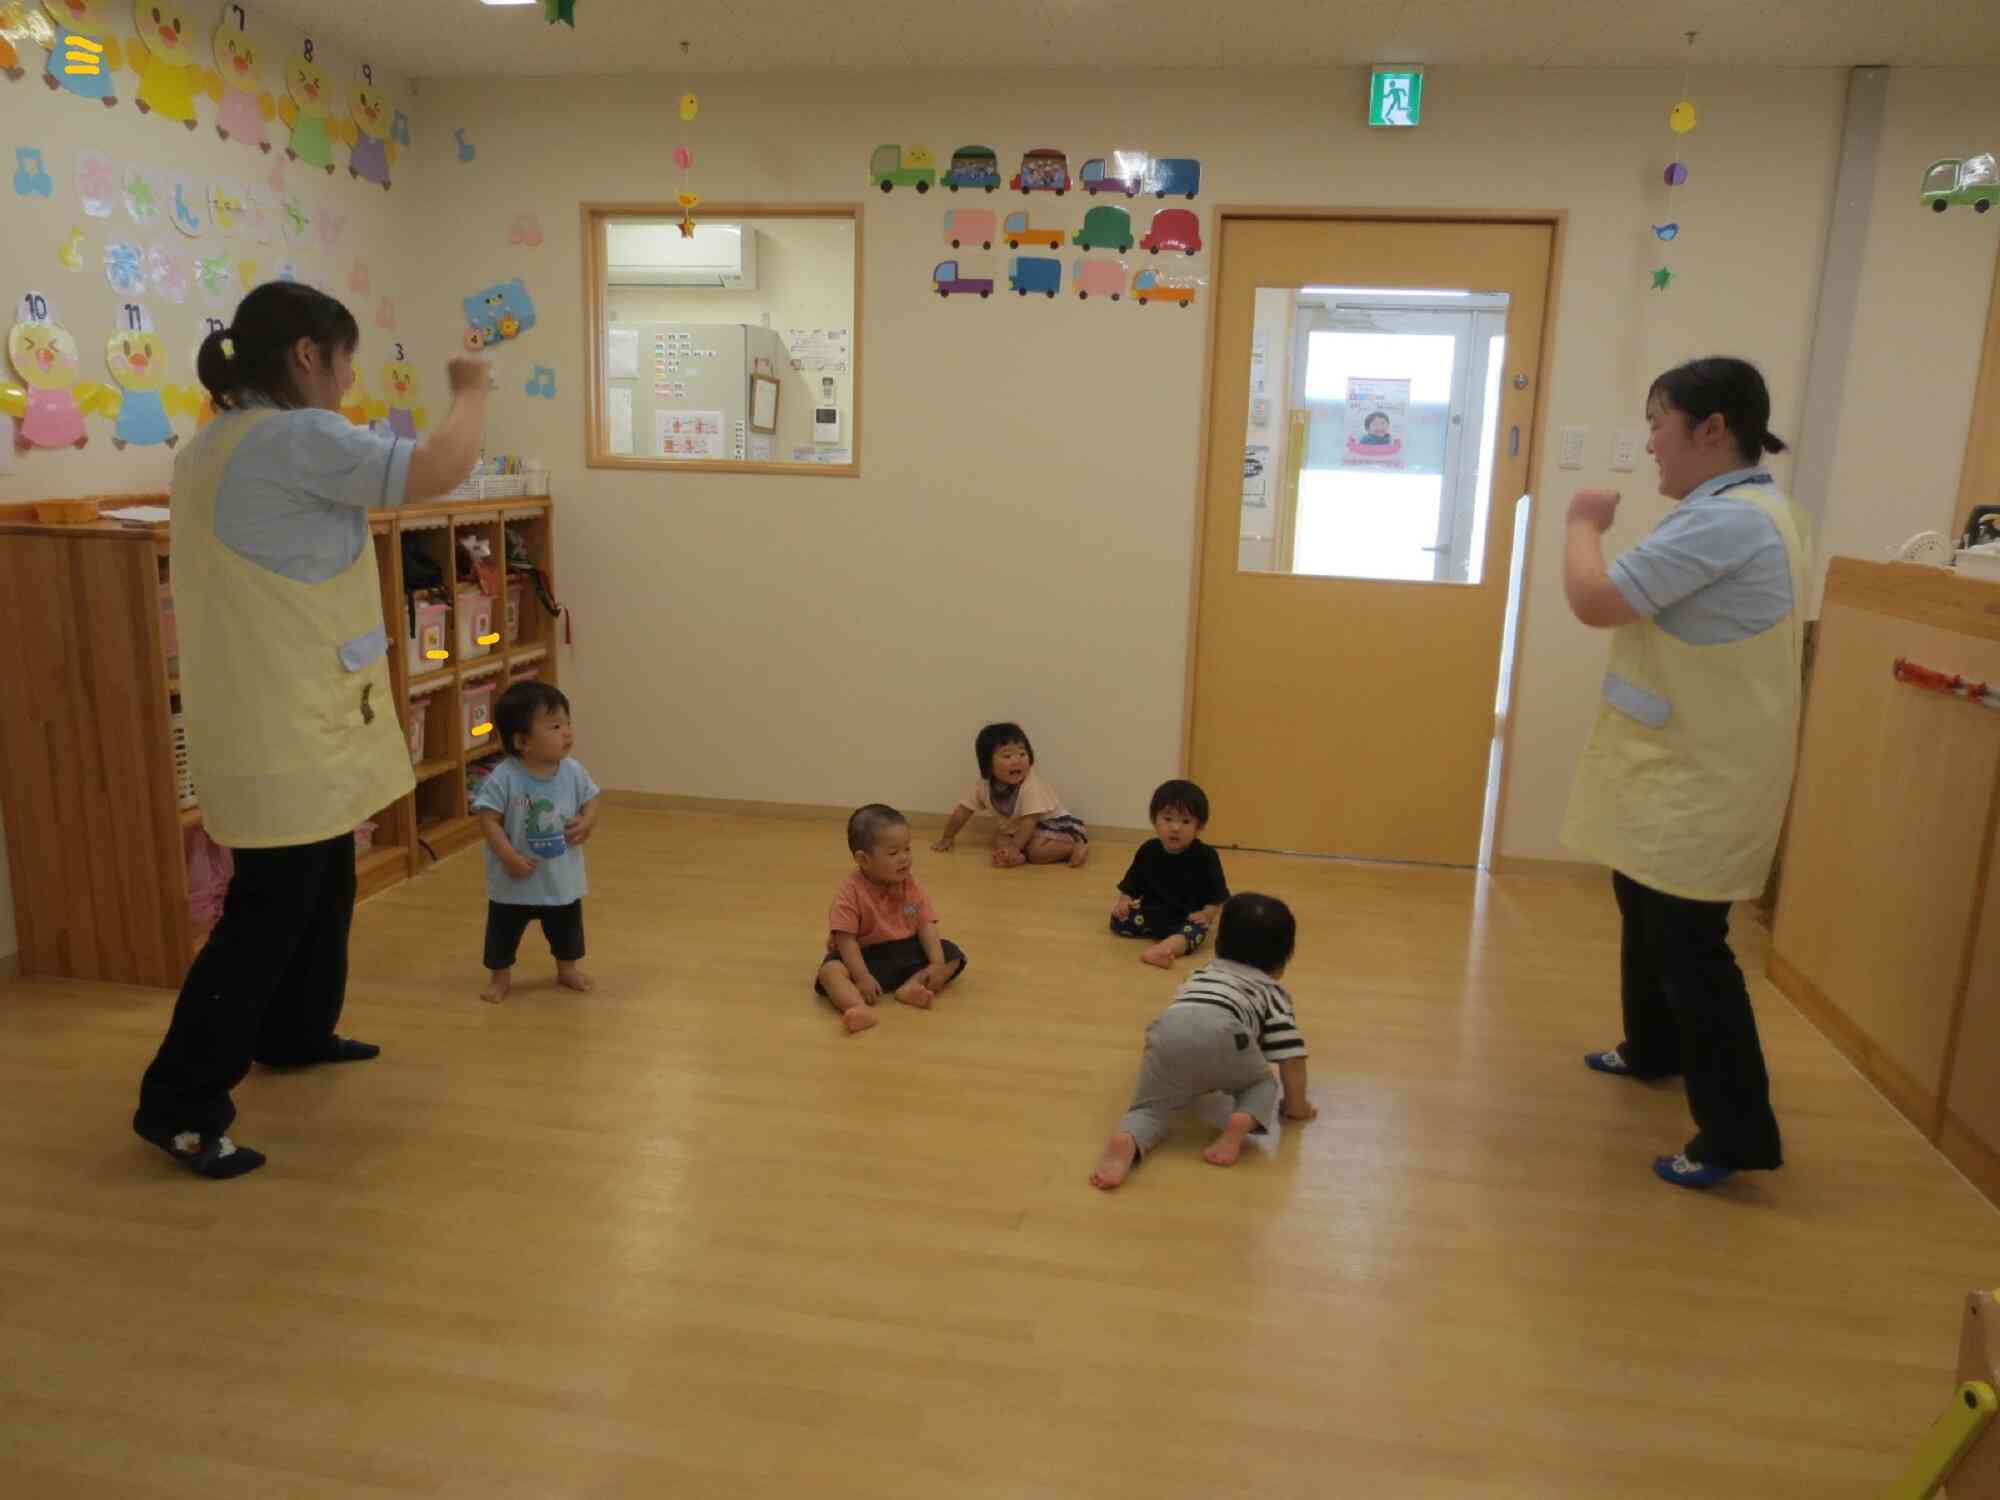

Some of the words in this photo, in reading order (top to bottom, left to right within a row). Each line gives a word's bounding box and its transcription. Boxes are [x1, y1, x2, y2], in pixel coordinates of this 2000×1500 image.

[232, 4, 245, 32] 7
[303, 38, 313, 63] 8
[362, 64, 372, 86] 9
[25, 293, 47, 321] 10
[124, 303, 141, 331] 11
[394, 343, 405, 361] 3
